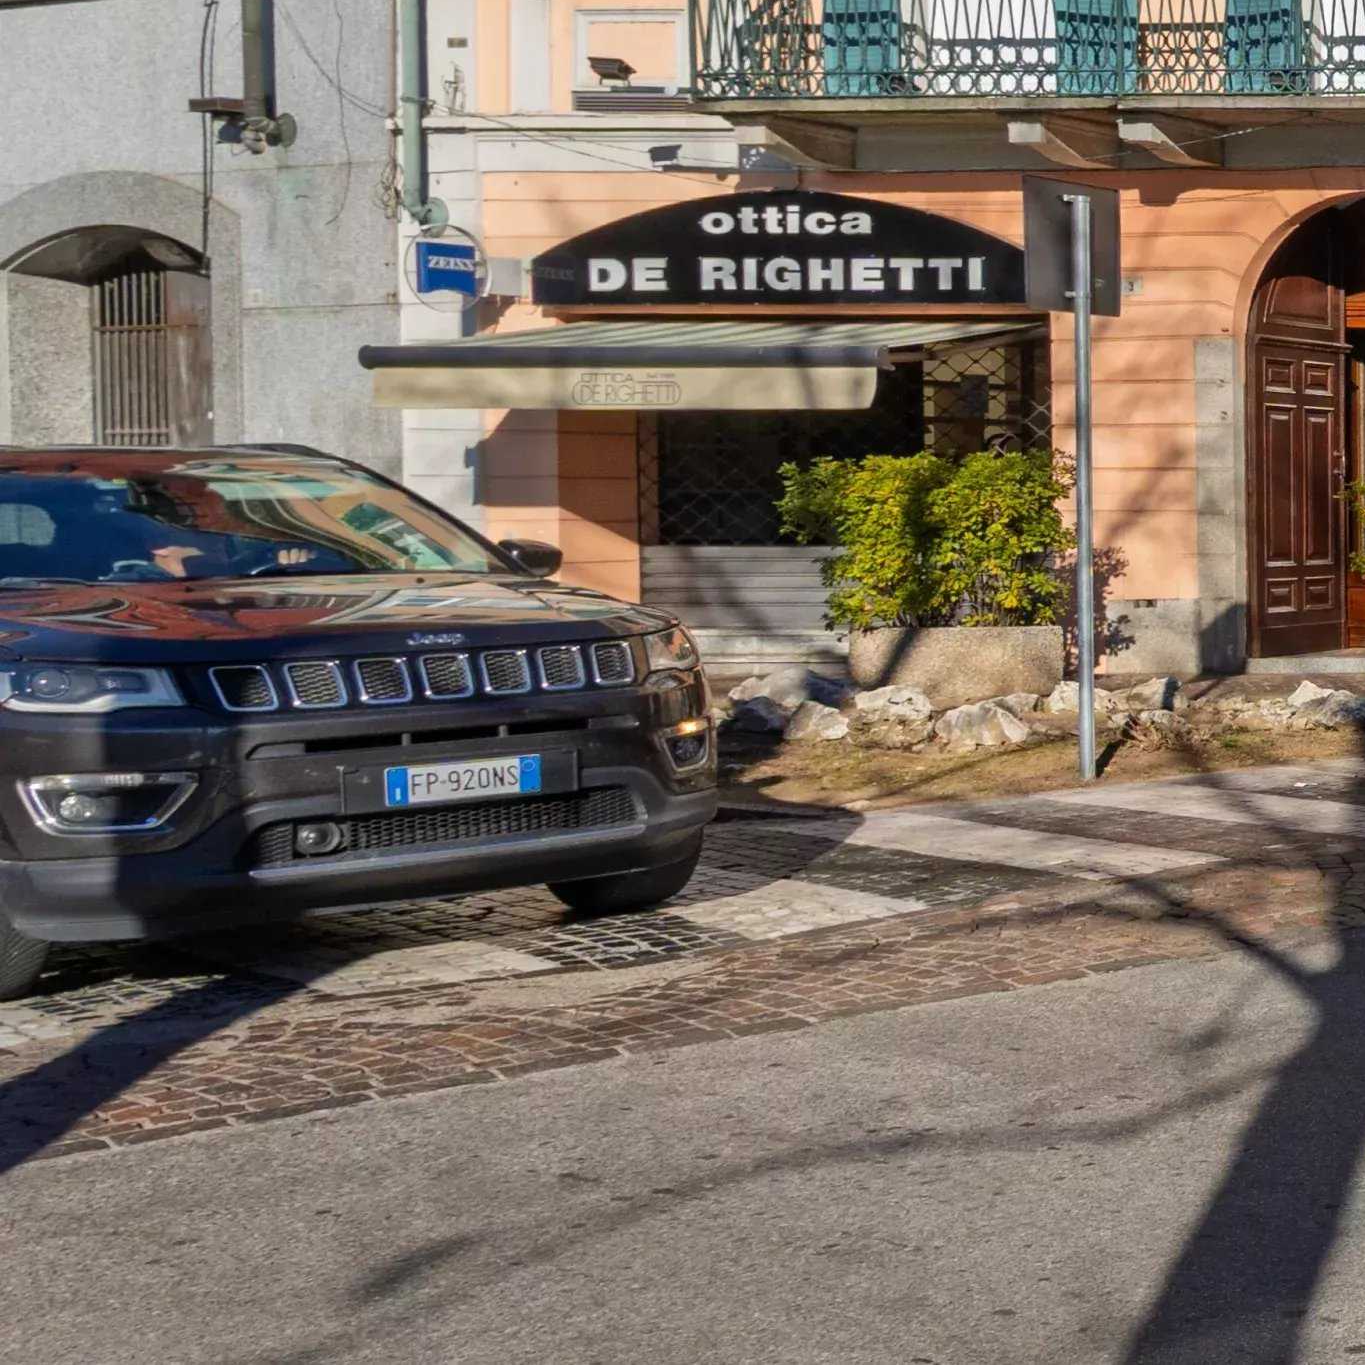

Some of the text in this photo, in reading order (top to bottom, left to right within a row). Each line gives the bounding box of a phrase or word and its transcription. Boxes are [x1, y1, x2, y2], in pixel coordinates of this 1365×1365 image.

[701, 205, 872, 235] ottica
[427, 255, 475, 271] ZEISS
[587, 256, 668, 292] DE
[701, 255, 985, 292] RIGHETTI
